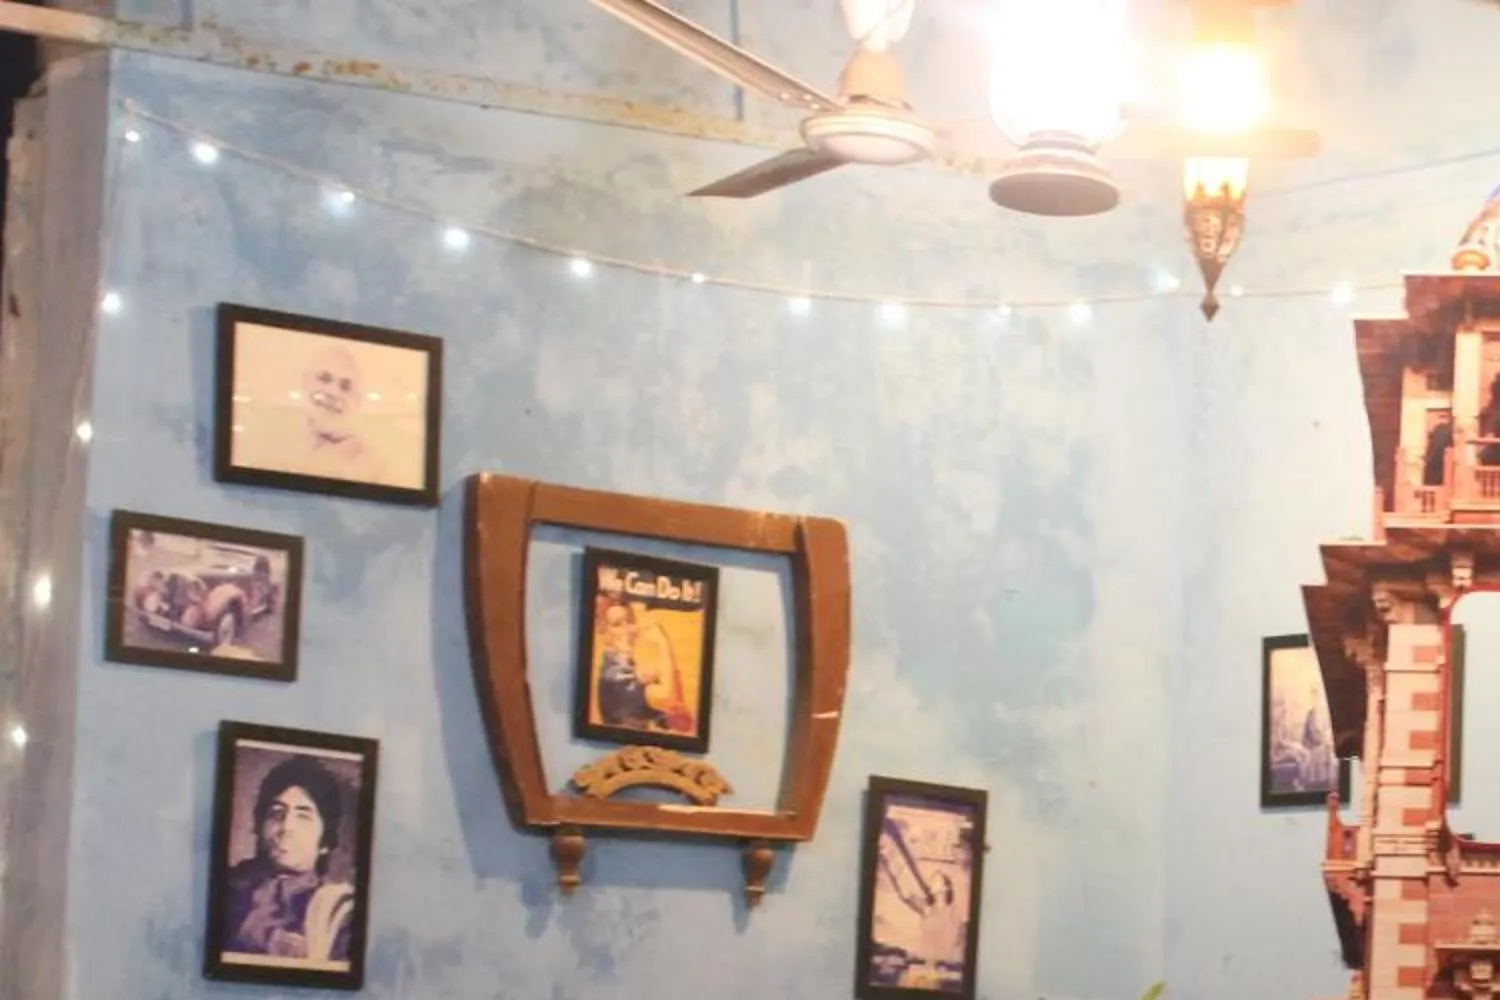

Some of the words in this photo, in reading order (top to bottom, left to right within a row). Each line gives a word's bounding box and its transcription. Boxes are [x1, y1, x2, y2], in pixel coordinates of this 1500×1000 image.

[625, 571, 656, 597] Can
[657, 575, 680, 600] Do
[681, 579, 702, 603] It!
